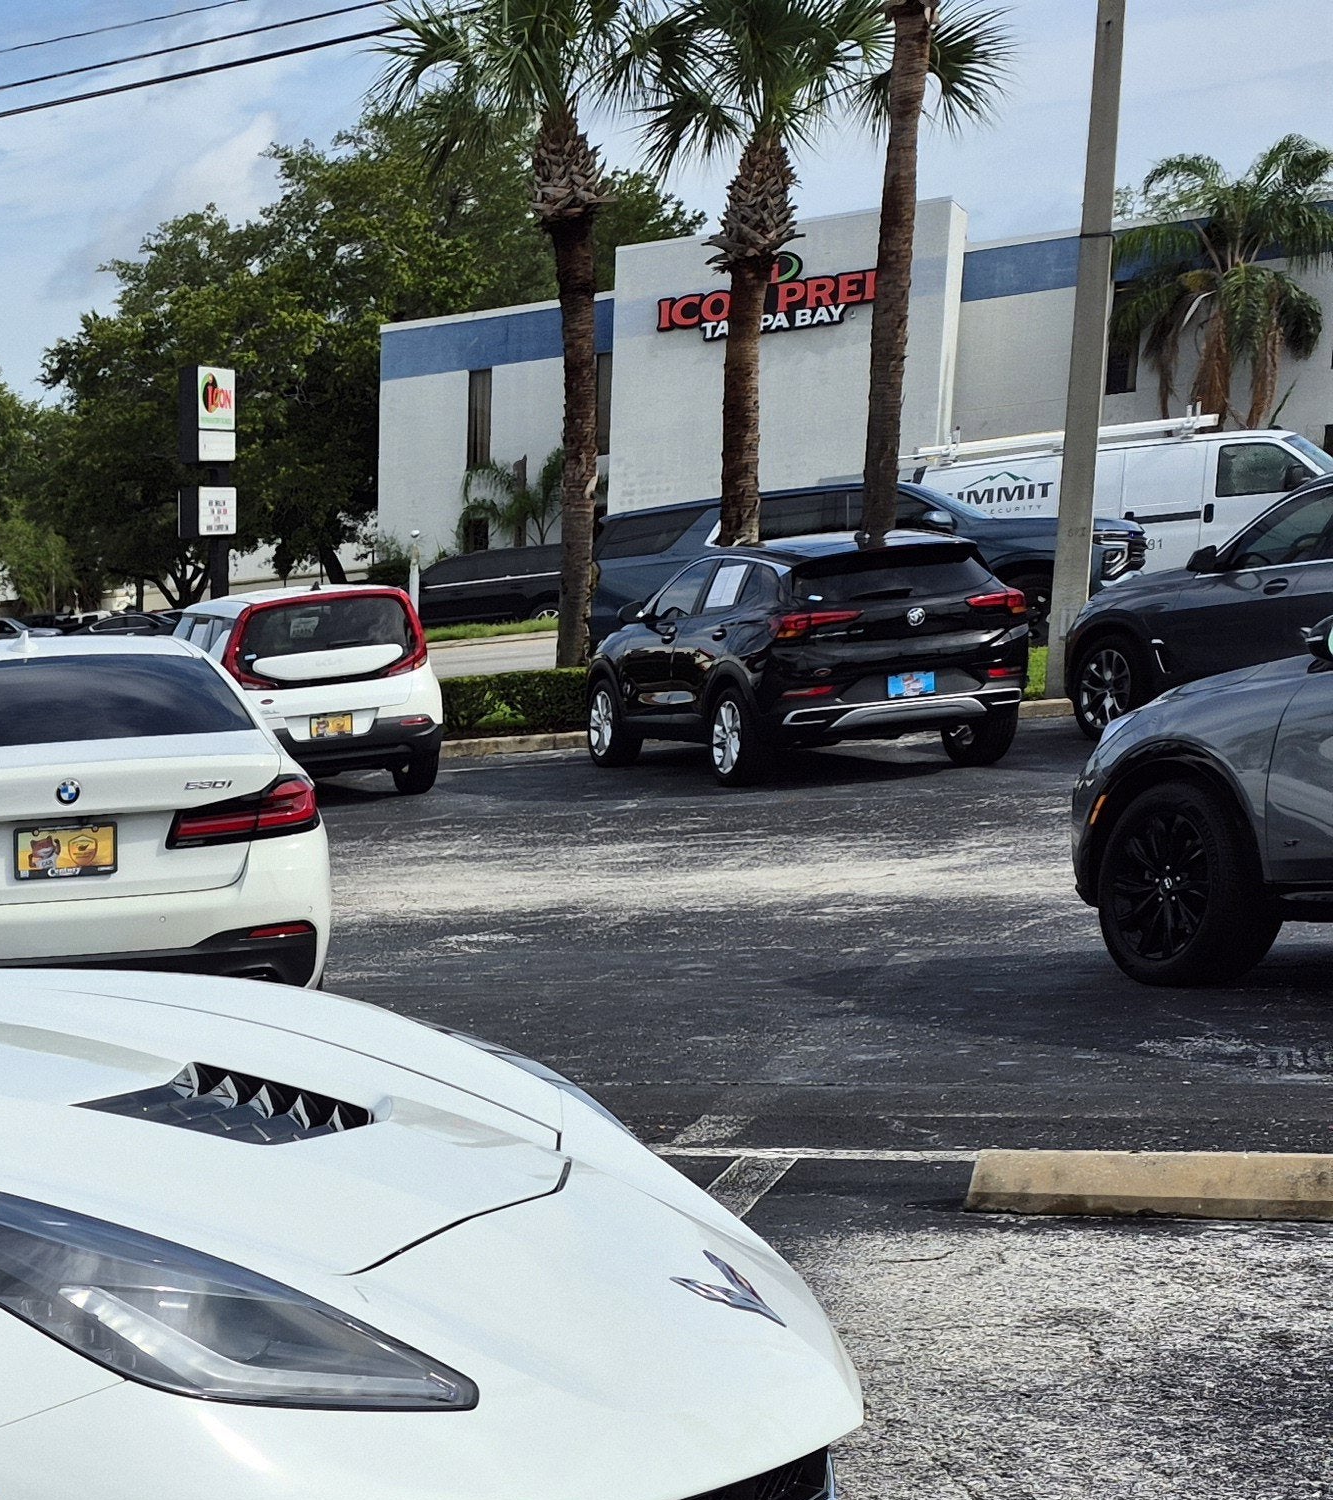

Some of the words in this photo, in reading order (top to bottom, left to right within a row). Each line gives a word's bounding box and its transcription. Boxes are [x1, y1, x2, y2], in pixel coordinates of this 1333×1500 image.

[658, 291, 731, 329] ICO
[702, 313, 788, 340] TAPA
[794, 304, 846, 328] BAY
[946, 481, 1055, 505] UMMIT
